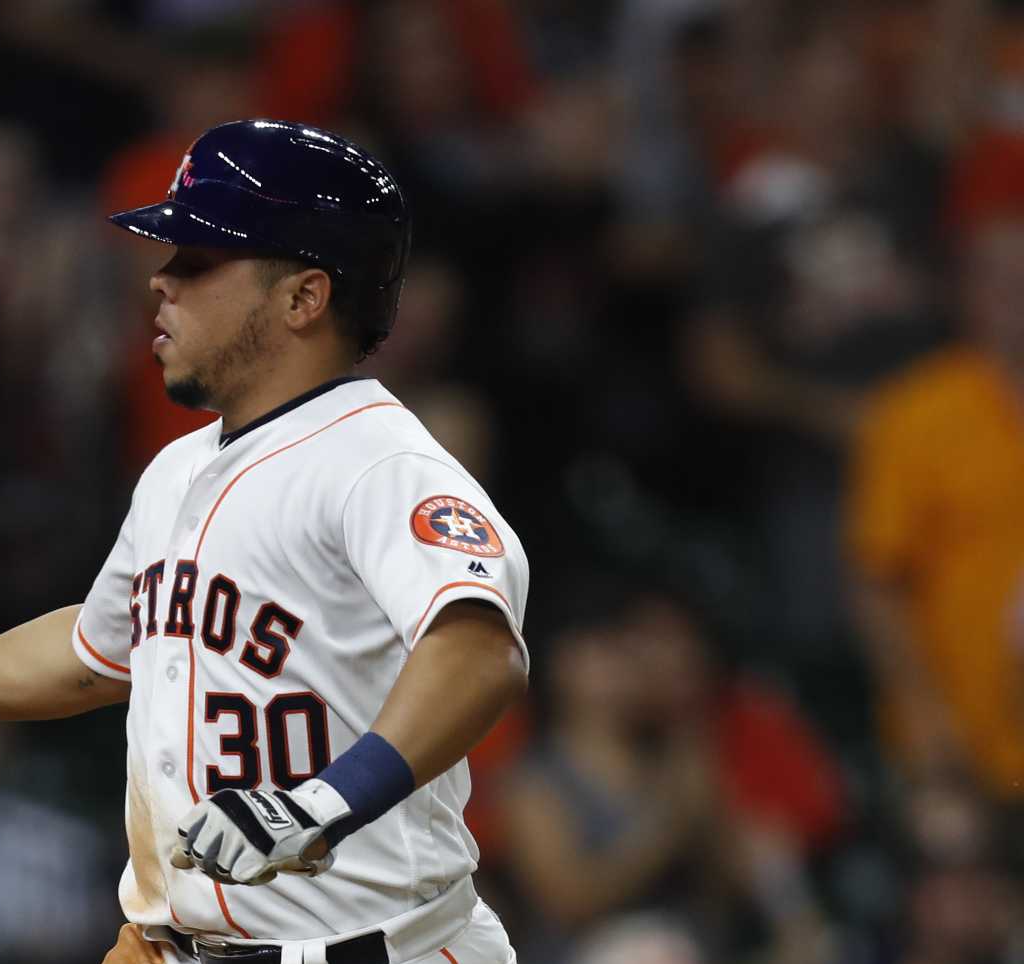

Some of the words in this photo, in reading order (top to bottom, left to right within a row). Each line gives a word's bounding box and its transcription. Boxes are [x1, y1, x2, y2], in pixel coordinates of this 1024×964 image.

[417, 498, 485, 524] HOUSTON
[437, 536, 497, 553] ASTROS
[205, 692, 331, 795] 30
